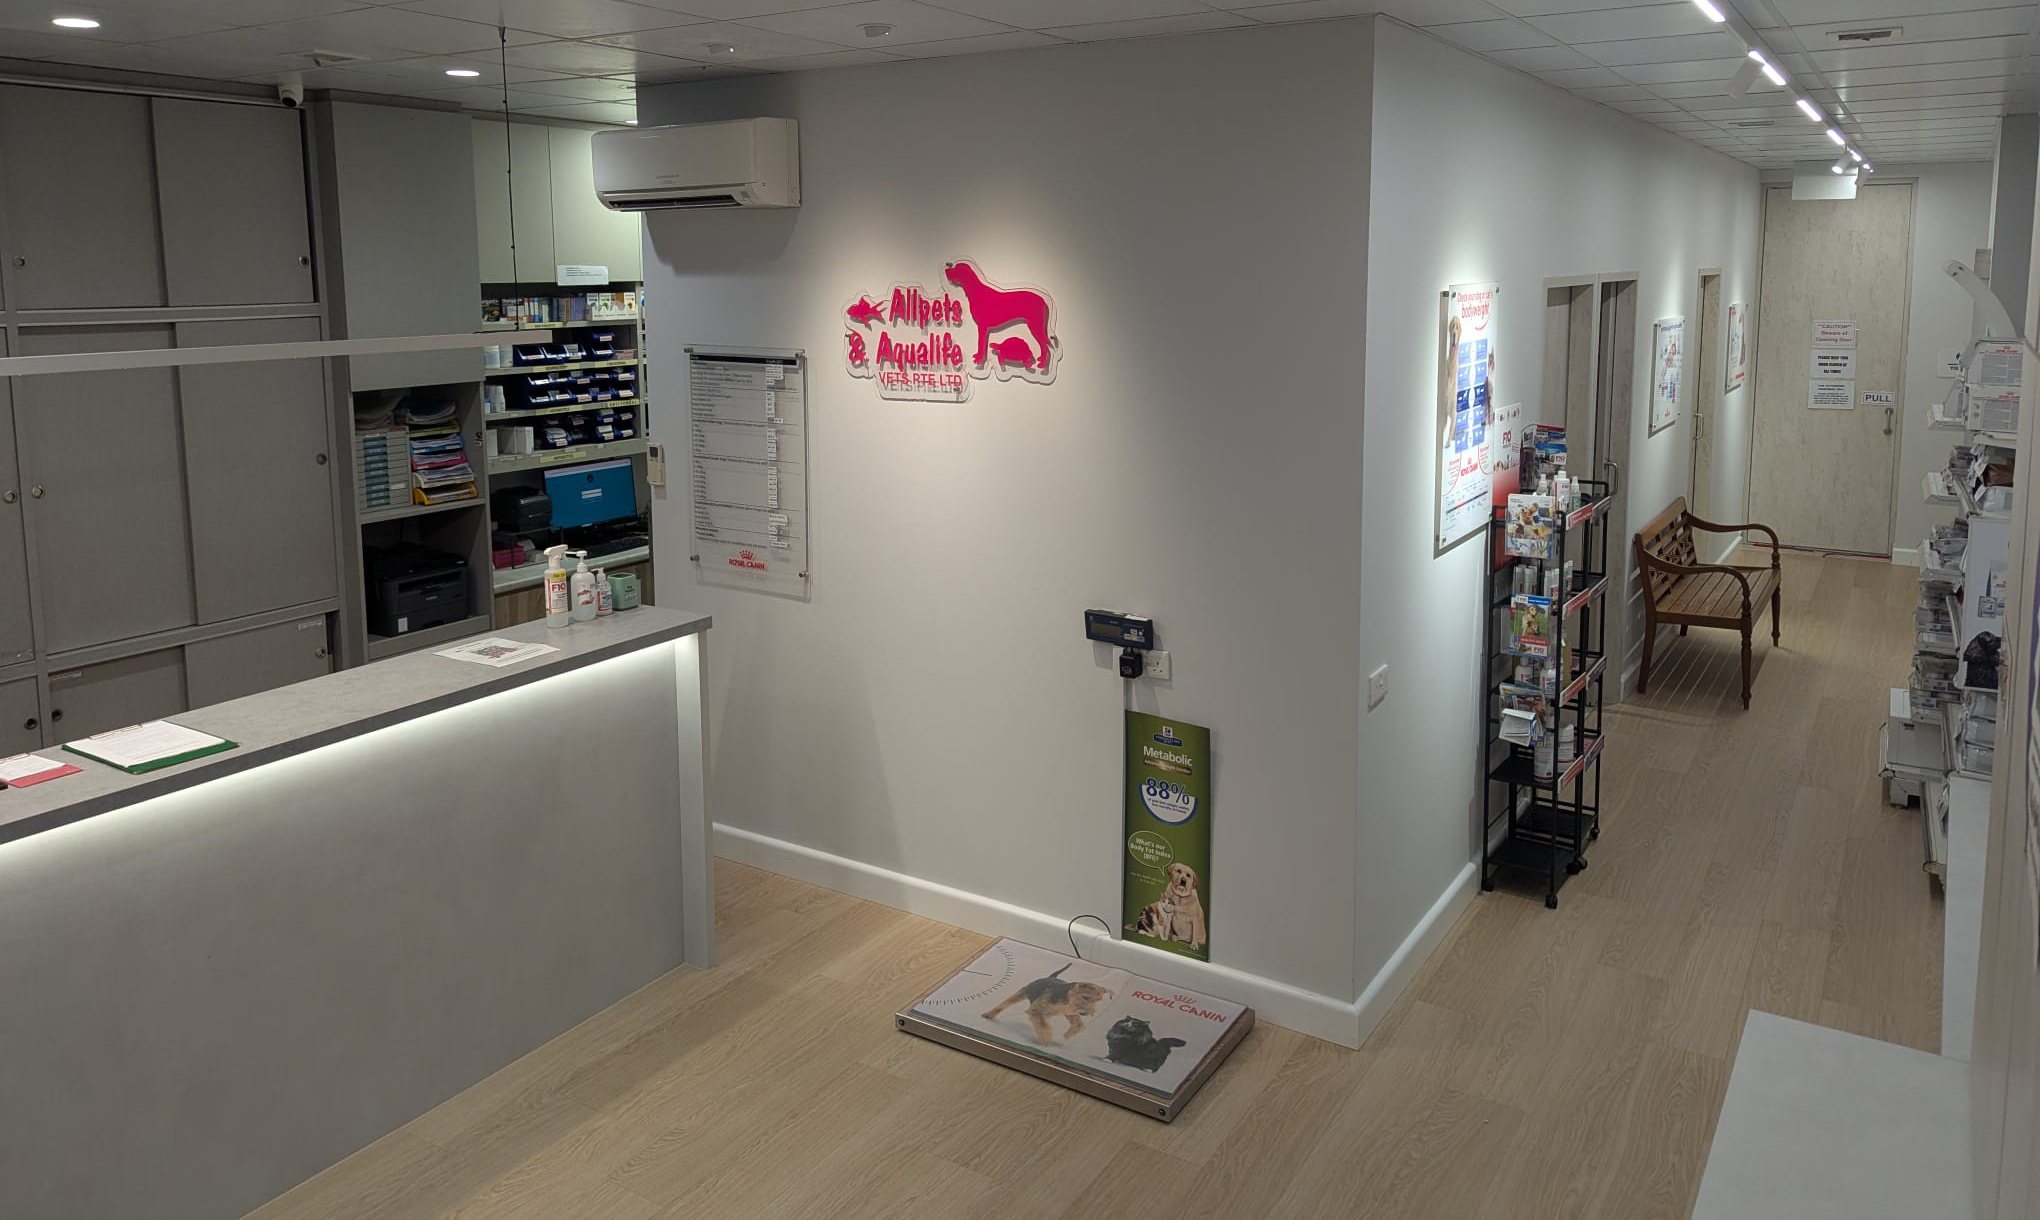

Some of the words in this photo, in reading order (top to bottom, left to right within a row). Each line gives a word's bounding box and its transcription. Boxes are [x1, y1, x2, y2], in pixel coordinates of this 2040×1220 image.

[889, 288, 962, 330] Allpets
[849, 332, 866, 363] &
[876, 331, 963, 372] Aqualife
[879, 372, 909, 385] VETS
[913, 373, 936, 386] PTE
[939, 374, 962, 387] LTD
[1866, 394, 1891, 403] PULL
[551, 583, 566, 592] F10
[1143, 745, 1192, 767] Metabolic
[1146, 778, 1189, 805] 88%
[1132, 990, 1175, 1009] ROYAL
[1179, 1004, 1227, 1023] CANIN
